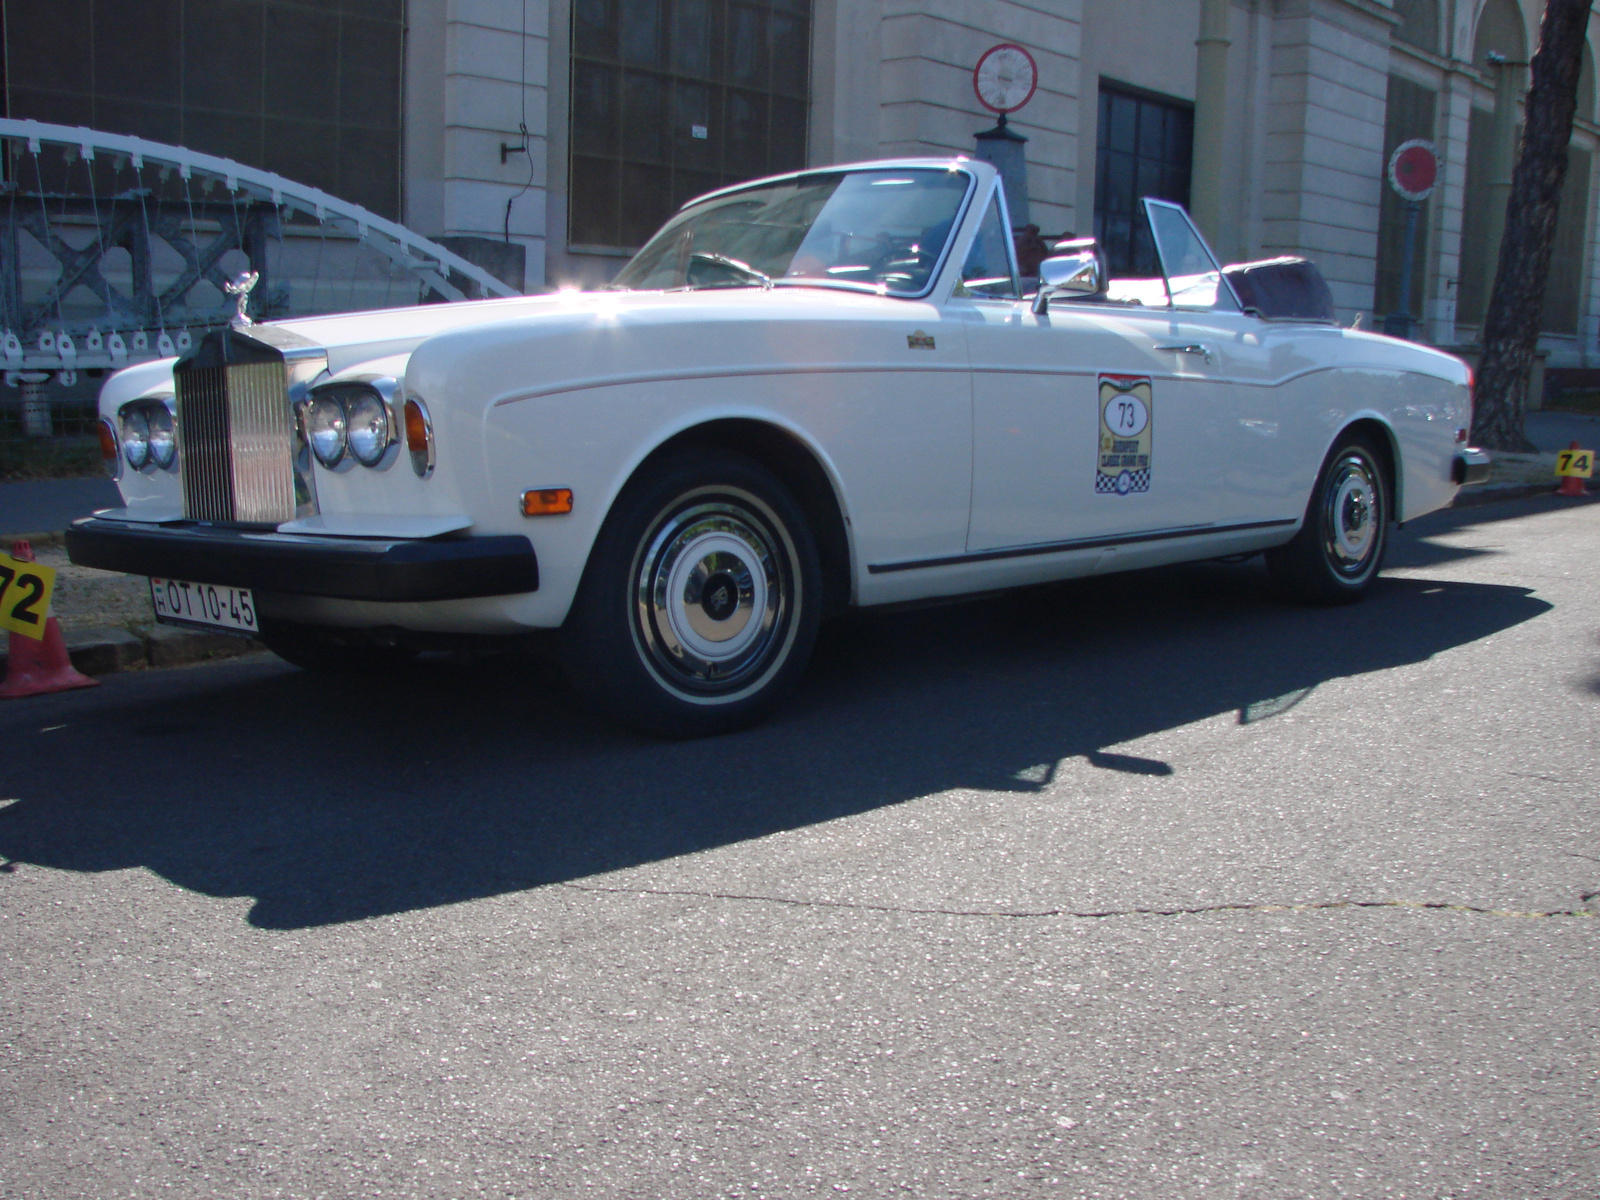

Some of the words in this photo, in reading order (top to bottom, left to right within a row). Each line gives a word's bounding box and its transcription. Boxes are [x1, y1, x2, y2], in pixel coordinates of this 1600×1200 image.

[1118, 402, 1134, 428] 73
[1560, 454, 1588, 472] 74
[0, 564, 45, 625] 72
